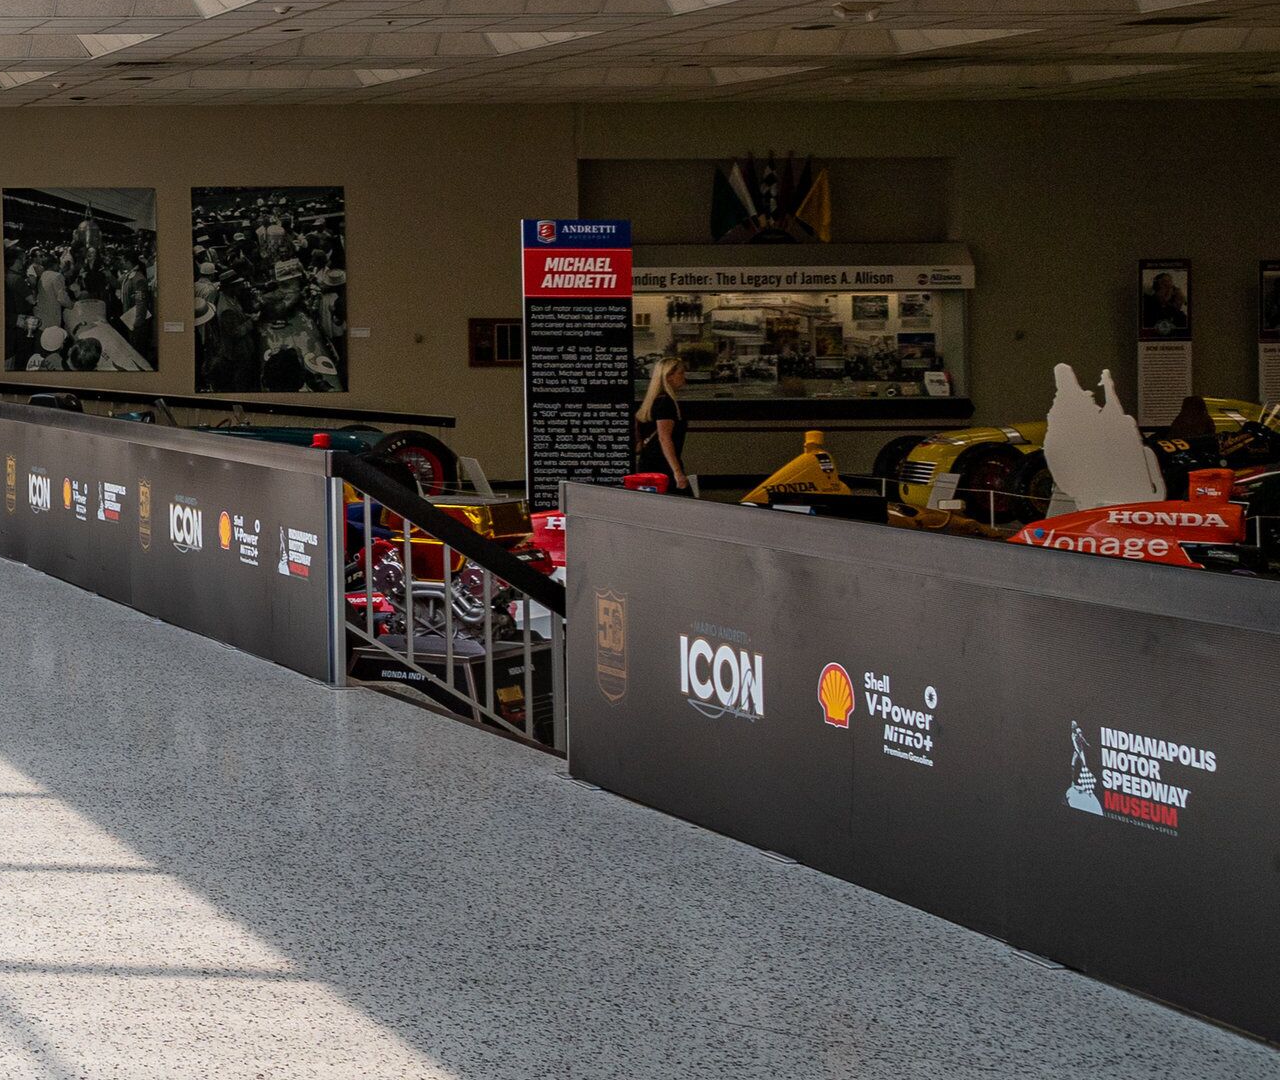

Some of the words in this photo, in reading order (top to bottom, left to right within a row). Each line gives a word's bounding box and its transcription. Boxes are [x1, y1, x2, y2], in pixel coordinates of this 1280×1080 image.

[562, 225, 617, 233] ANDRETTI
[544, 257, 613, 272] MICHAEL
[670, 272, 713, 286] Father:
[716, 272, 737, 286] The
[740, 272, 783, 288] Legacy
[786, 272, 798, 286] of
[800, 272, 838, 287] James
[840, 272, 852, 286] A.
[855, 272, 894, 286] Allison
[540, 274, 617, 289] ANDRETTI
[28, 473, 50, 509] ICON
[169, 503, 203, 549] ICON
[1107, 510, 1229, 528] HONDA
[381, 670, 407, 680] HONDA
[680, 635, 764, 716] ICON
[864, 672, 890, 693] Shell
[865, 692, 933, 730] V-Power
[1100, 726, 1217, 772] INDIANAPOLIS
[1101, 748, 1161, 780] MOTOR
[1102, 769, 1190, 809] SPEEDWAY
[1104, 790, 1178, 828] MUSEUM
